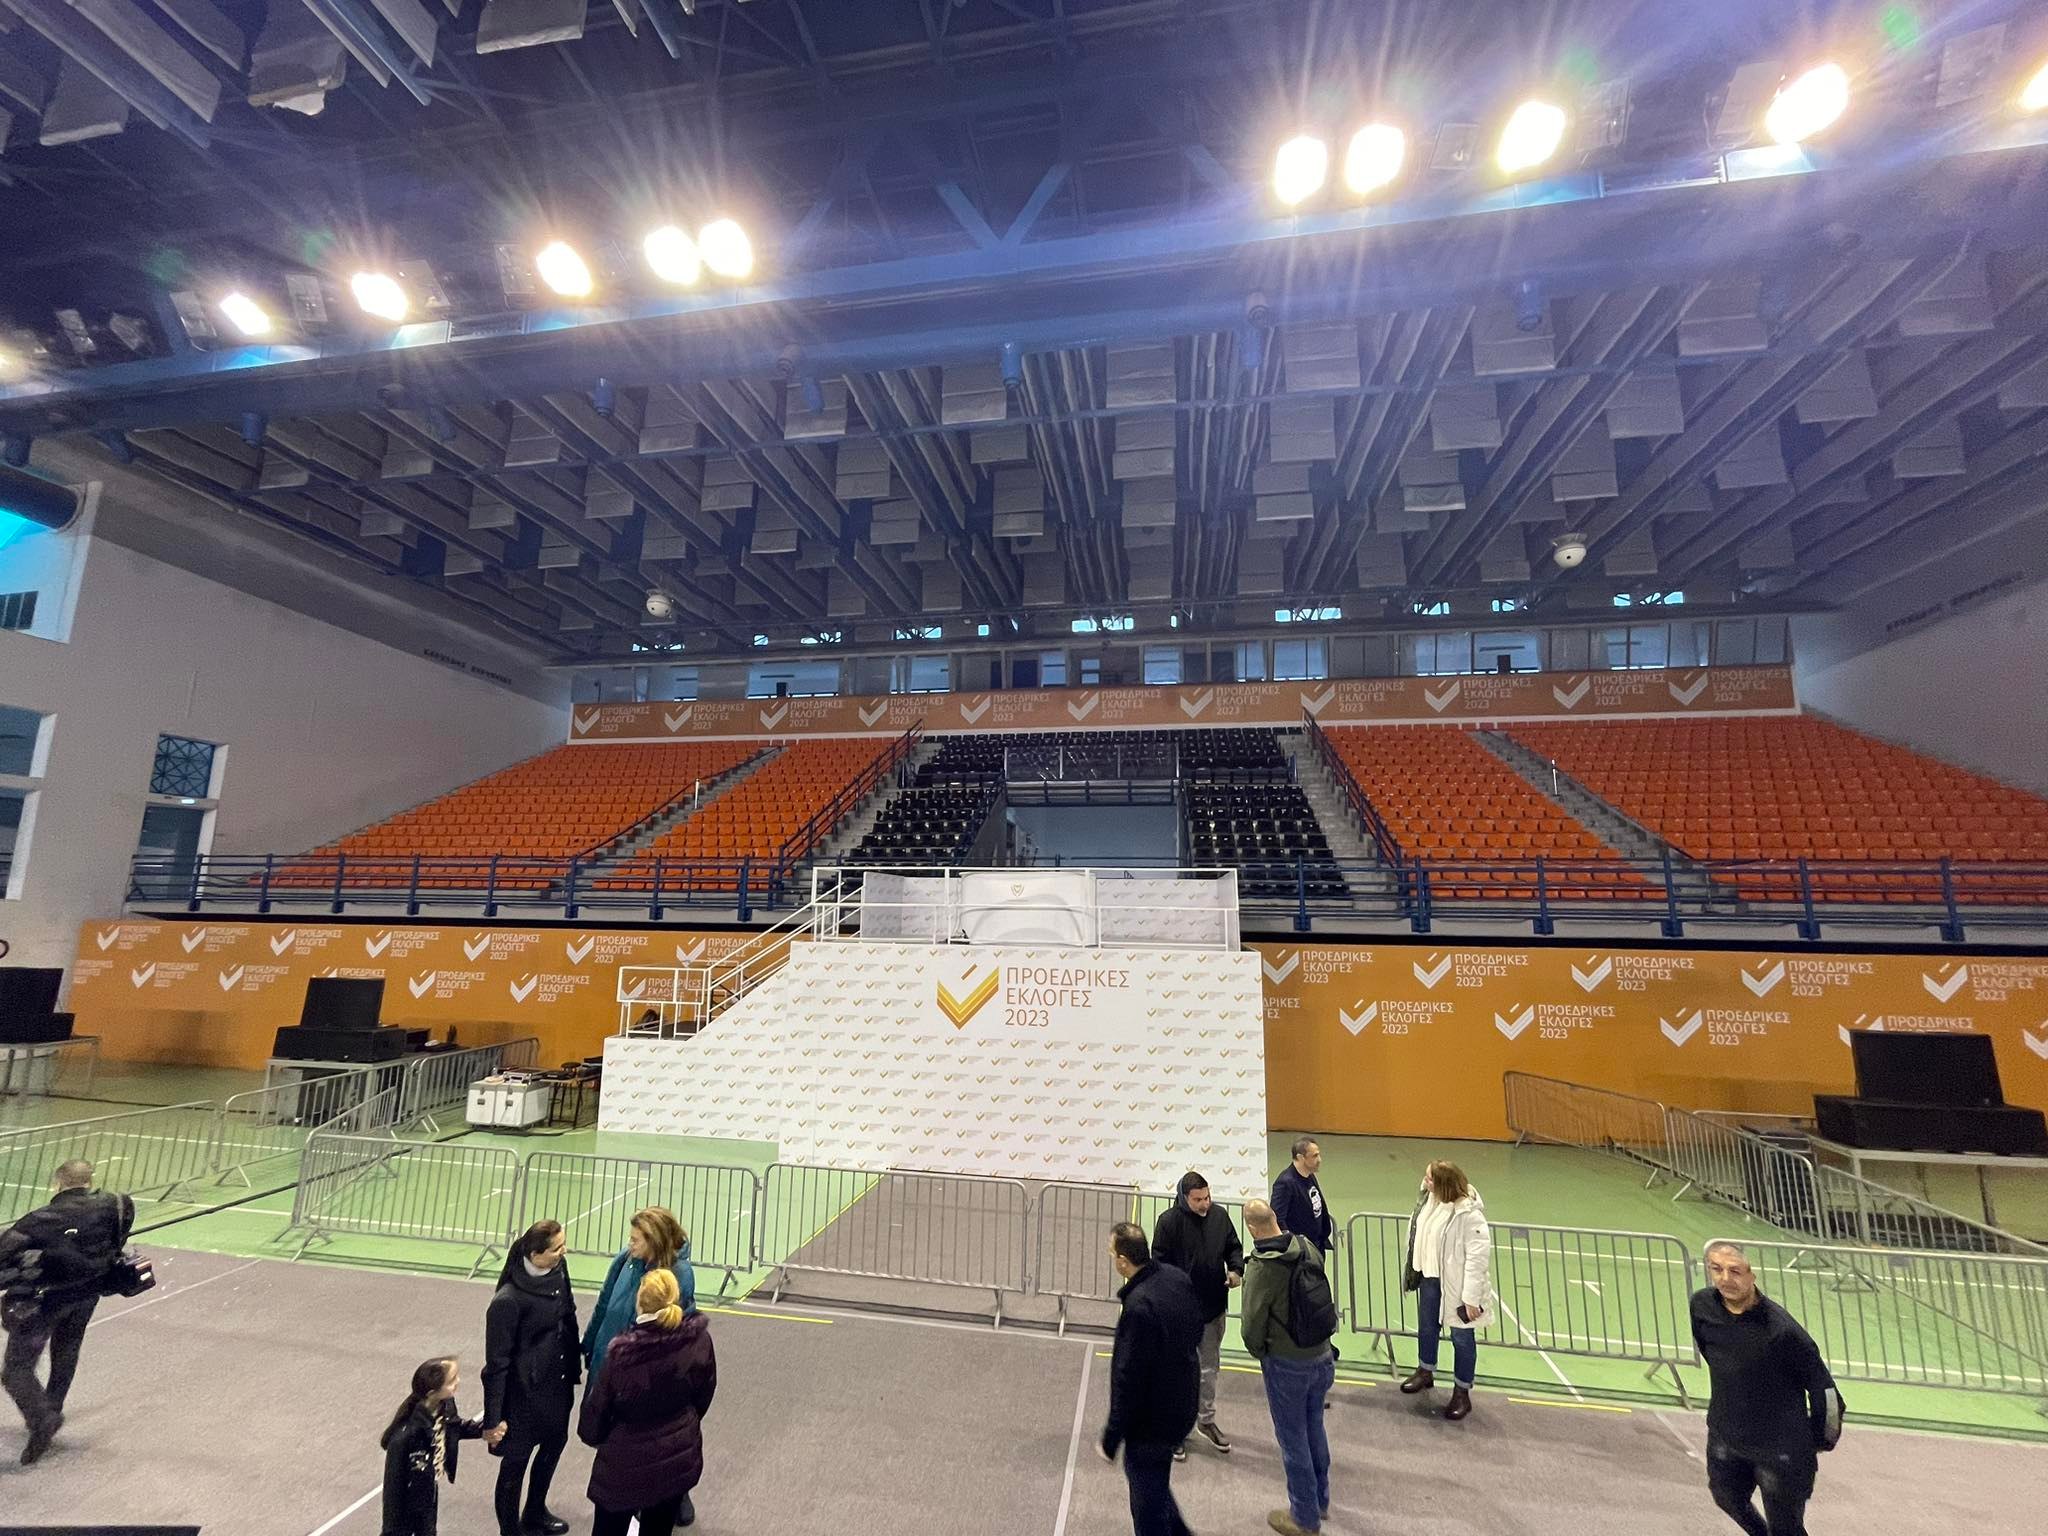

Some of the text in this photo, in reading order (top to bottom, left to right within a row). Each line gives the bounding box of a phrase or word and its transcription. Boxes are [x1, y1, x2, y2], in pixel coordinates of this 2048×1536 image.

[392, 931, 440, 941] ΠΡΟΕΔΡΙΚΕΣ
[492, 933, 540, 943] ΠΡΟΕΔΡΙΚΕΣ
[596, 936, 648, 945] ΠΡΟΕΔΡΙΚΕΣ
[391, 939, 424, 948] ΕΚΛΟΓΕΣ
[491, 942, 525, 952] ΕΚΛΟΓΕΣ
[596, 945, 632, 954] ΕΚΛΟΓΕΣ
[490, 951, 508, 960] 2023
[594, 955, 614, 963] 2023
[1302, 951, 1373, 962] ΠΡΟΕΔΡΙΚΕΣ
[1455, 954, 1528, 966] ΠΡΟΕΔΡΙΚΕΣ
[1303, 961, 1352, 973] ΕΚΛΟΓΕΣ
[1615, 957, 1695, 968] ΠΡΟΕΔΡΙΚΕΣ
[1789, 960, 1873, 974] ΠΡΟΕΔΡΙΚΕΣ
[1456, 964, 1507, 976] ΕΚΛΟΓΕΣ
[1616, 968, 1672, 980] ΕΚΛΟΓΕΣ
[1971, 964, 2048, 976] ΠΡΟΕΔΡΙΚΕ
[437, 971, 485, 981] ΠΡΟΕΔΡΙΚΕΣ
[540, 974, 589, 985] ΠΡΟΕΔΡΙΚΕΣ
[1007, 967, 1130, 988] ΠΡΟΕΔΡΙΚΕΣ
[1303, 972, 1328, 983] 2023
[1791, 973, 1850, 985] ΕΚΛΟΓΕΣ
[436, 980, 470, 990] ΕΚΛΟΓΕΣ
[1456, 976, 1483, 988] 2023
[1617, 980, 1646, 991] 2023
[539, 983, 574, 994] ΕΚΛΟΓΕΣ
[1792, 985, 1822, 996] 2023
[538, 993, 557, 1002] 2023
[1006, 988, 1092, 1008] ΕΚΛΟΓΕΣ
[1263, 998, 1300, 1008] ΔΡΙΚΕΣ
[1381, 1000, 1454, 1013] ΠΡΟΕΔΡΙΚΕΣ
[1538, 1004, 1615, 1016] ΠΡΟΕΔΡΙΚΕΣ
[1005, 1009, 1050, 1027] 2023
[1382, 1012, 1432, 1024] ΕΚΛΟΓΕΣ
[1539, 1016, 1593, 1028] ΕΚΛΟΓΕΣ
[1707, 1010, 1791, 1023] ΠΡΟΕΔΡΙΚΕΣ
[1708, 1022, 1767, 1034] ΕΚΛΟΓΕΣ
[1888, 1016, 1973, 1029] ΠΡΟΕΔΡΙΚΕΣ
[1382, 1023, 1408, 1035] 2023
[1540, 1027, 1568, 1039] 2023
[1709, 1034, 1739, 1045] 2023
